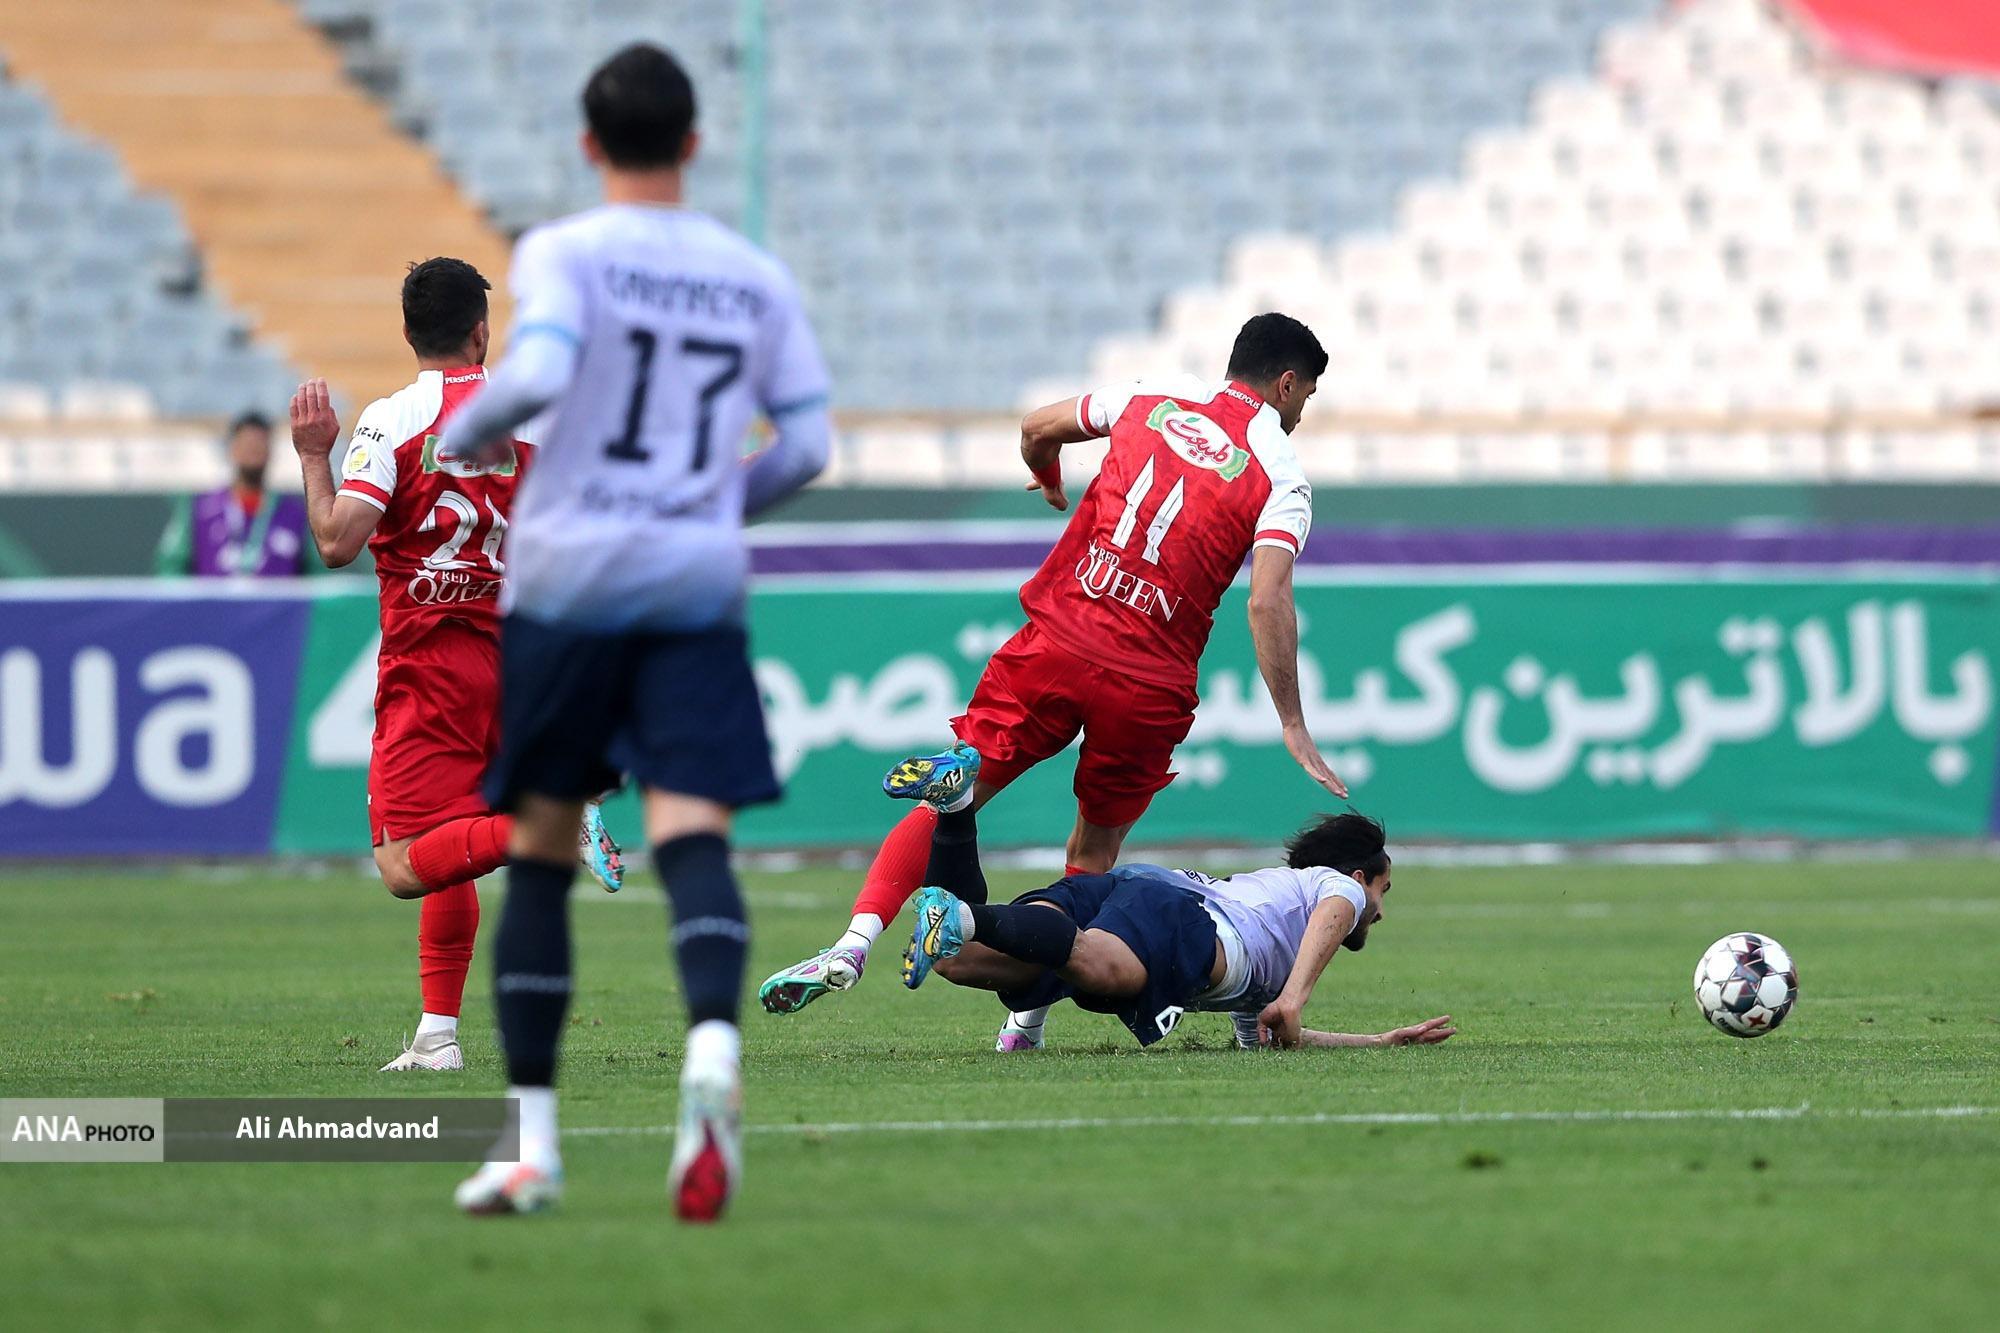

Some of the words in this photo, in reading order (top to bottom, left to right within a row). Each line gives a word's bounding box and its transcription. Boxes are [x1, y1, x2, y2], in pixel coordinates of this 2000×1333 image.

[445, 373, 484, 384] PERSEPOLIS
[604, 326, 745, 474] 17
[1225, 388, 1261, 410] PERSEPOLIS
[1164, 418, 1232, 464] طبیعت
[417, 490, 509, 574] 21
[1110, 453, 1185, 566] 11
[442, 570, 470, 584] RED
[1098, 548, 1120, 567] RED
[407, 576, 507, 605] QUEE
[1074, 551, 1183, 622] QUEEN
[1462, 599, 1993, 792] بالاترین
